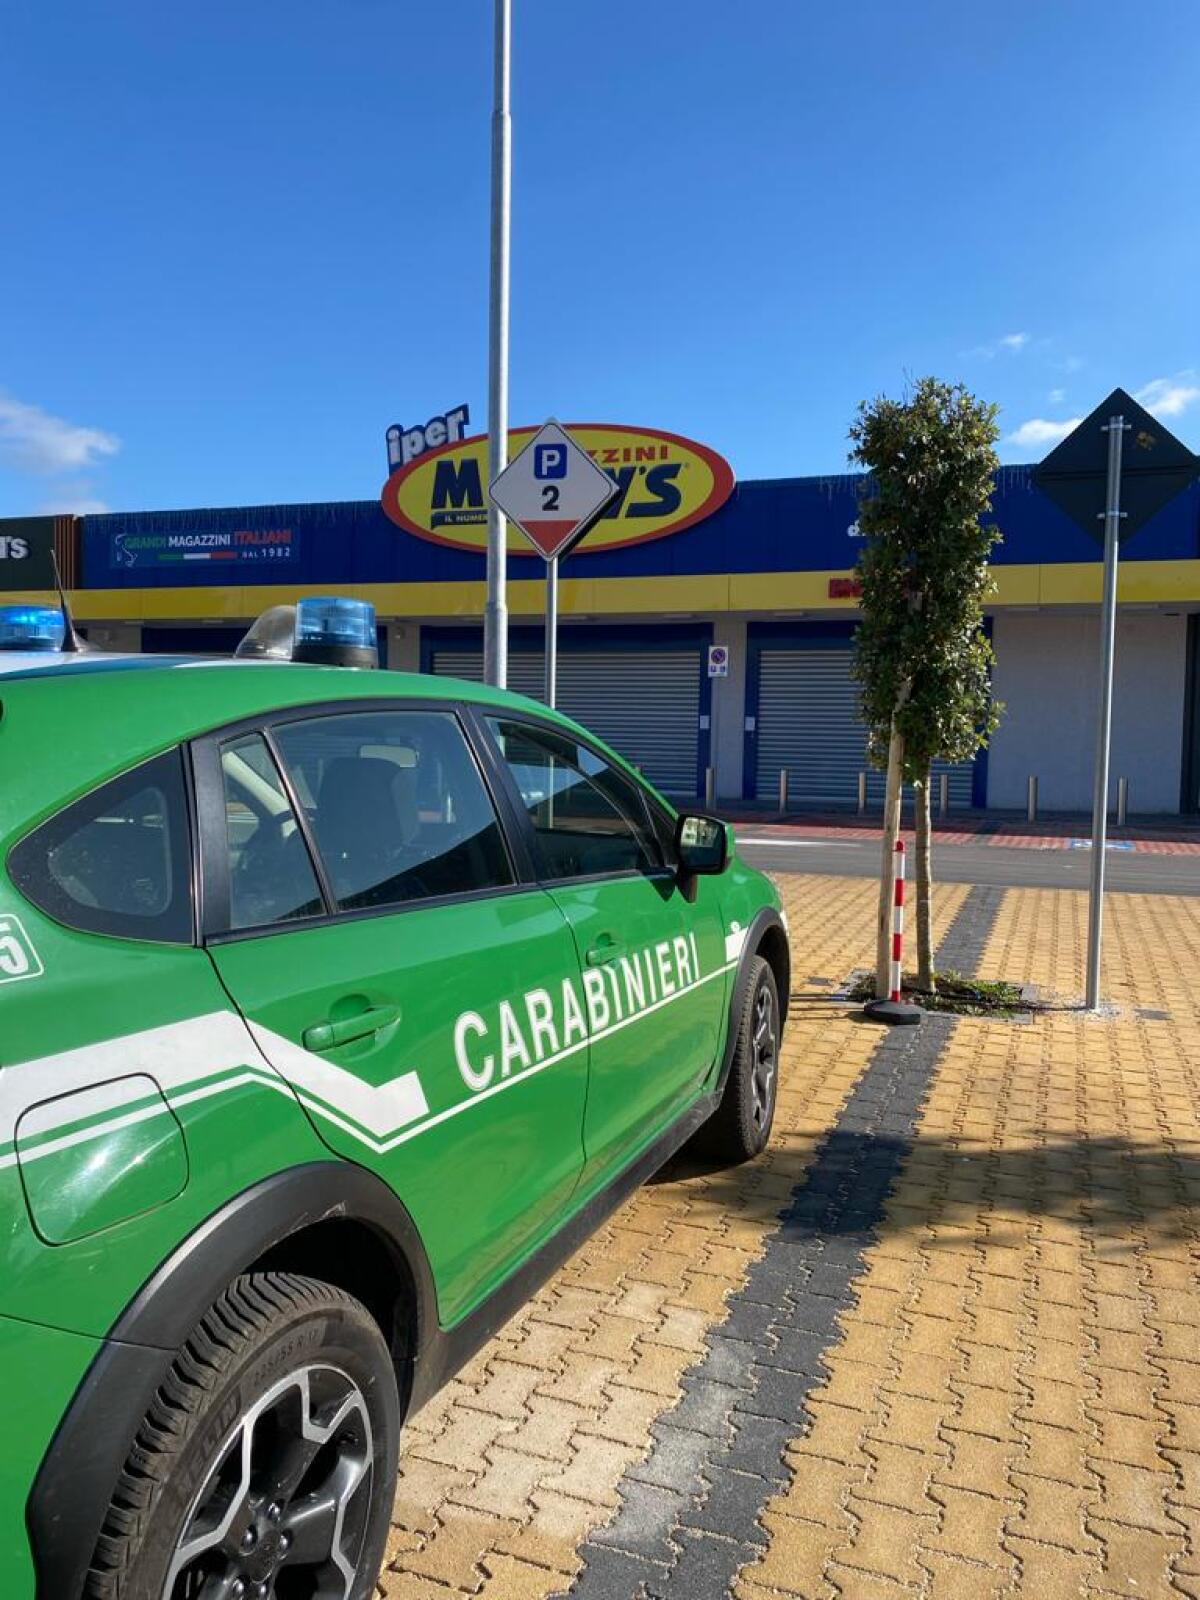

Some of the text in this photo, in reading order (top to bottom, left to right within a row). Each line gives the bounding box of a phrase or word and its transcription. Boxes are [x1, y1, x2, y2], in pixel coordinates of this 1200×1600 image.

[386, 404, 468, 466] iper
[541, 449, 561, 476] P
[541, 486, 560, 511] 2
[126, 529, 292, 549] GRANDI MAGAZZINI ITALIANI
[262, 547, 290, 558] 1982
[454, 931, 700, 1093] CARABINIERI
